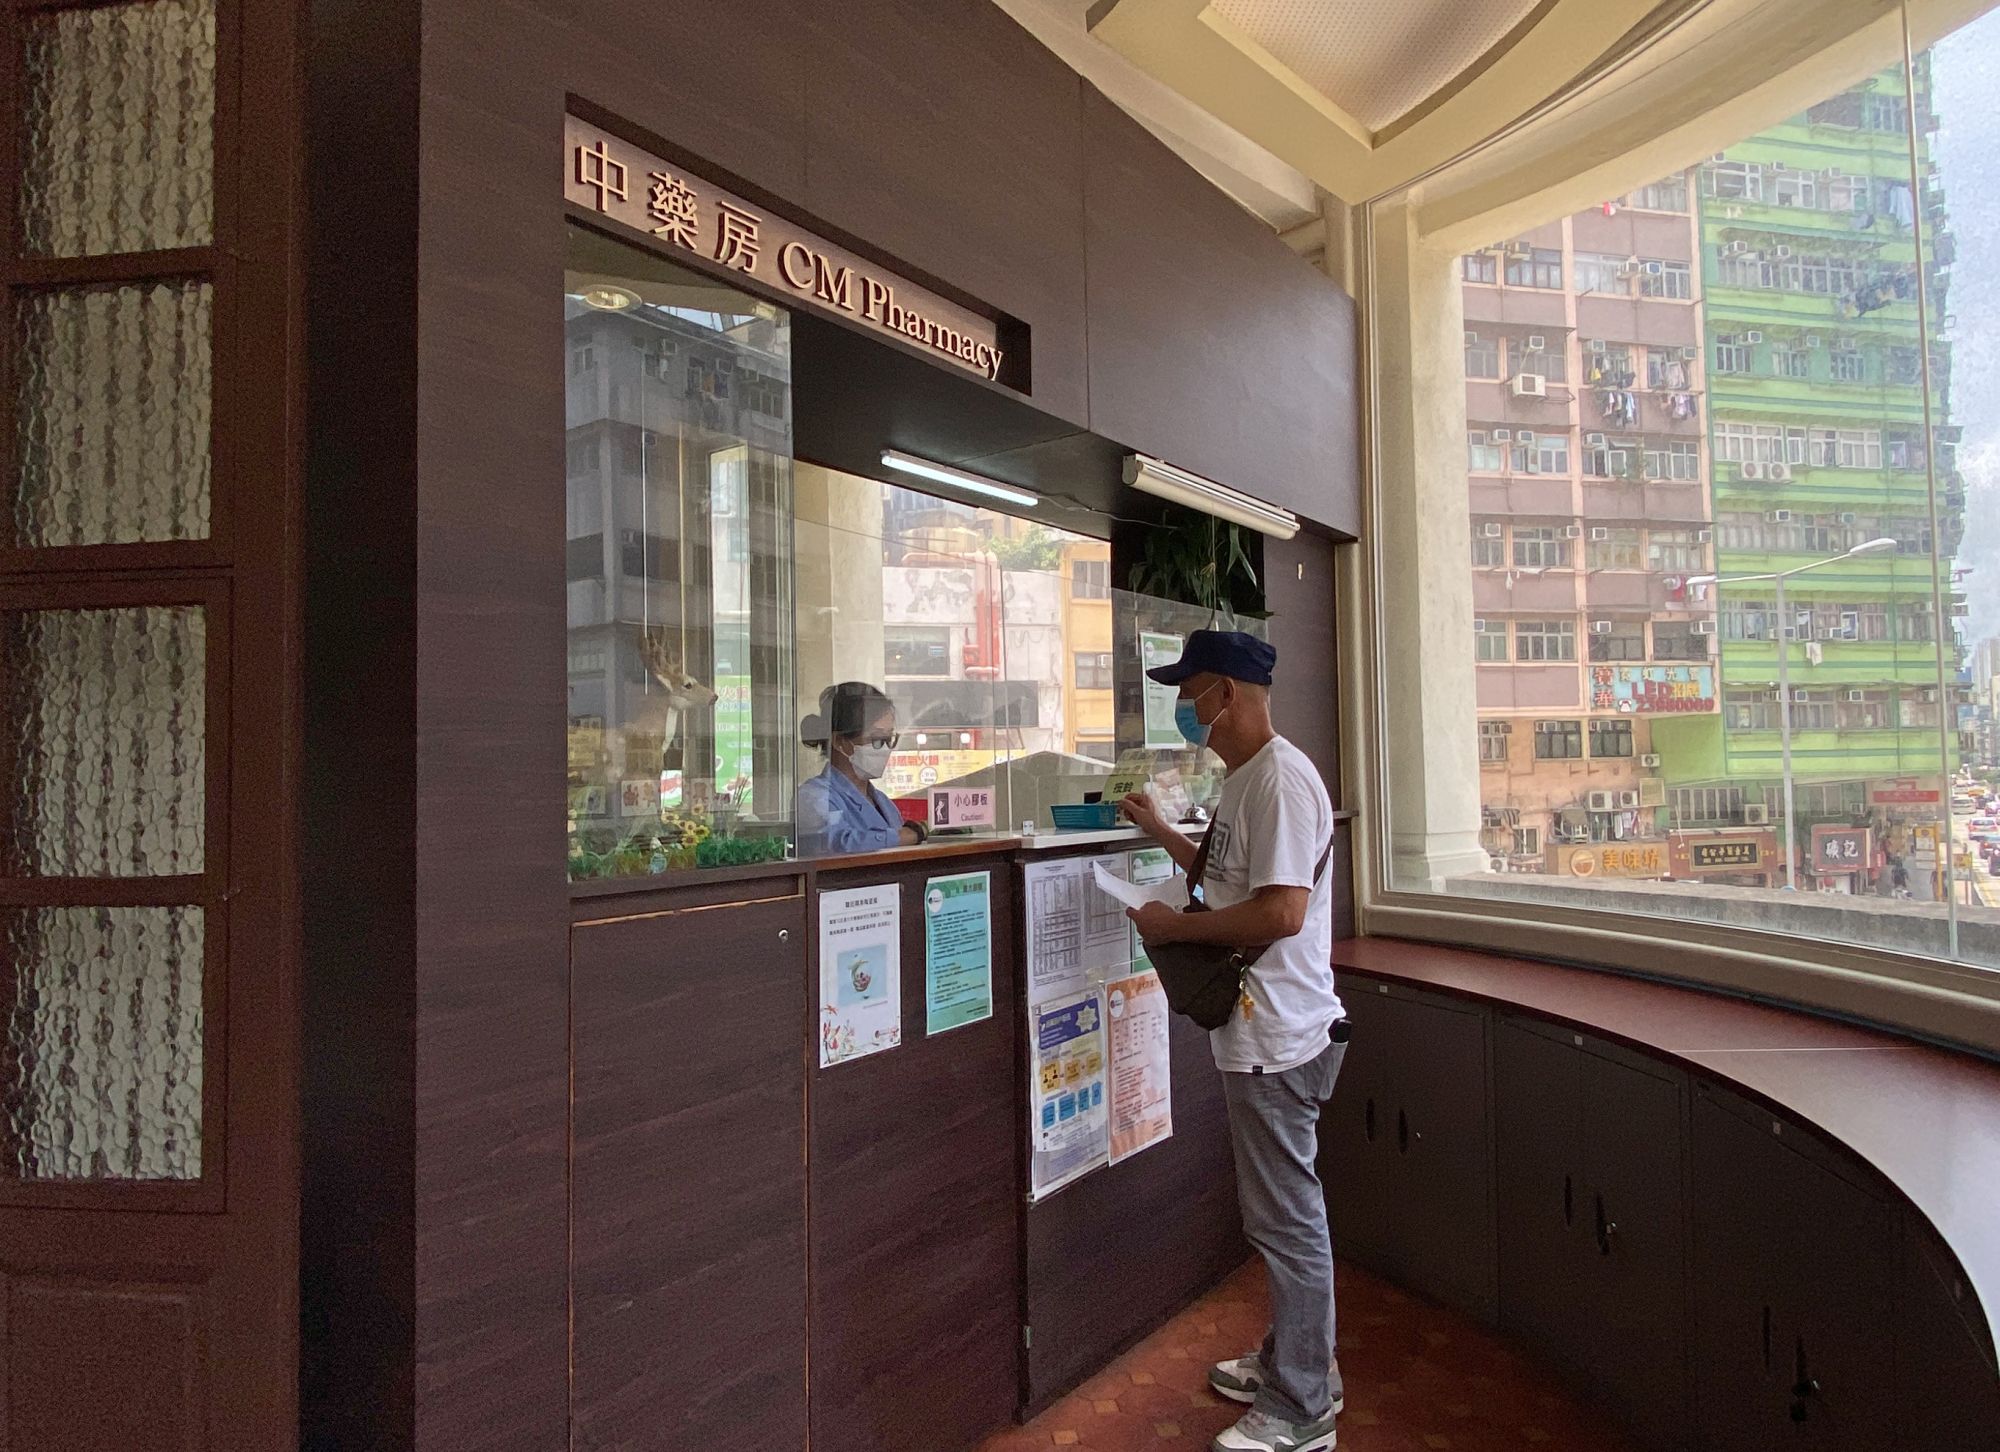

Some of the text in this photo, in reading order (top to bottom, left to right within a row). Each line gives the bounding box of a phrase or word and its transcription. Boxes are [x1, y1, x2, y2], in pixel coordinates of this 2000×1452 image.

[575, 141, 1004, 381] 中藥房 CM Pharmacy
[1601, 847, 1660, 872] 美味坊
